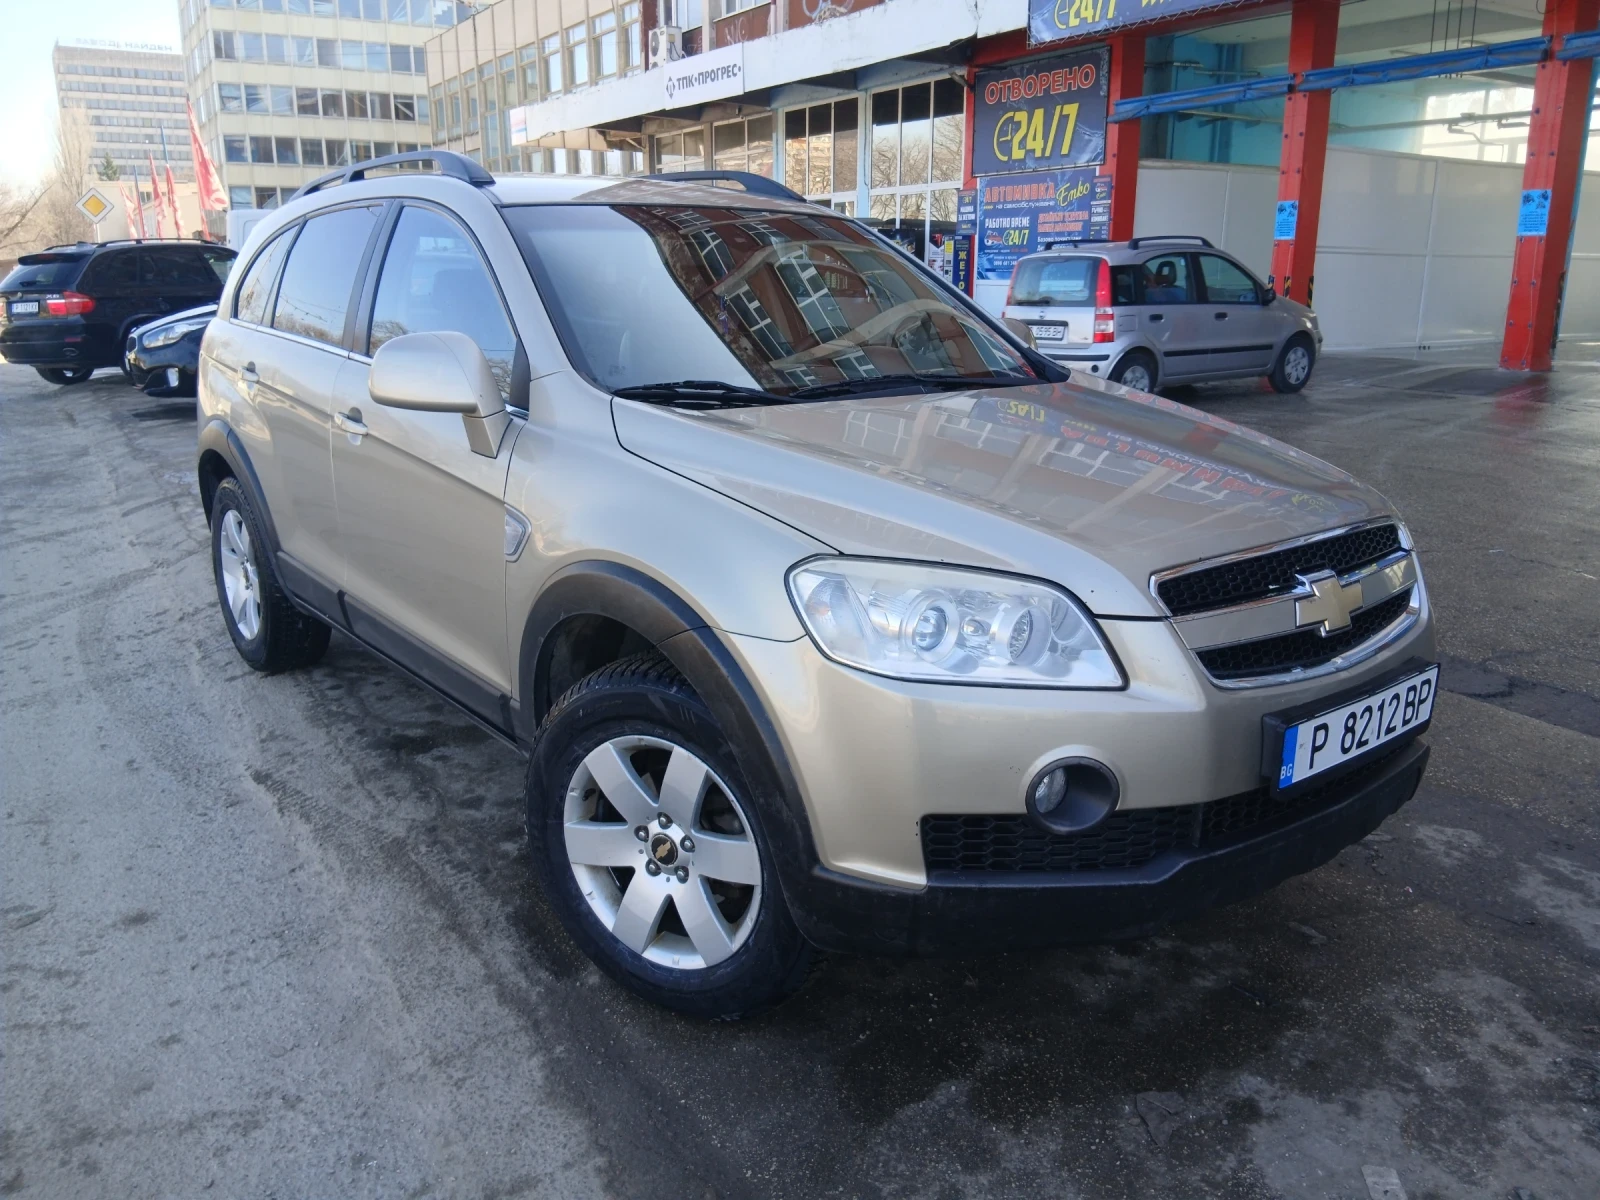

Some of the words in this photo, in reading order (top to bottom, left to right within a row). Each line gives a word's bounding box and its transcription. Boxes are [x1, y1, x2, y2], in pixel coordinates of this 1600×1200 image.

[984, 63, 1096, 105] ОТВОРЕНО
[1011, 102, 1080, 160] 24/7
[984, 182, 1056, 203] АВТОМИВКА
[1004, 201, 1055, 209] самообслужване
[985, 218, 1010, 228] РАБОТНО
[1011, 217, 1030, 227] ВРЕМЕ
[1008, 230, 1029, 246] 24/7
[1308, 722, 1330, 770] P
[1280, 763, 1293, 780] BG
